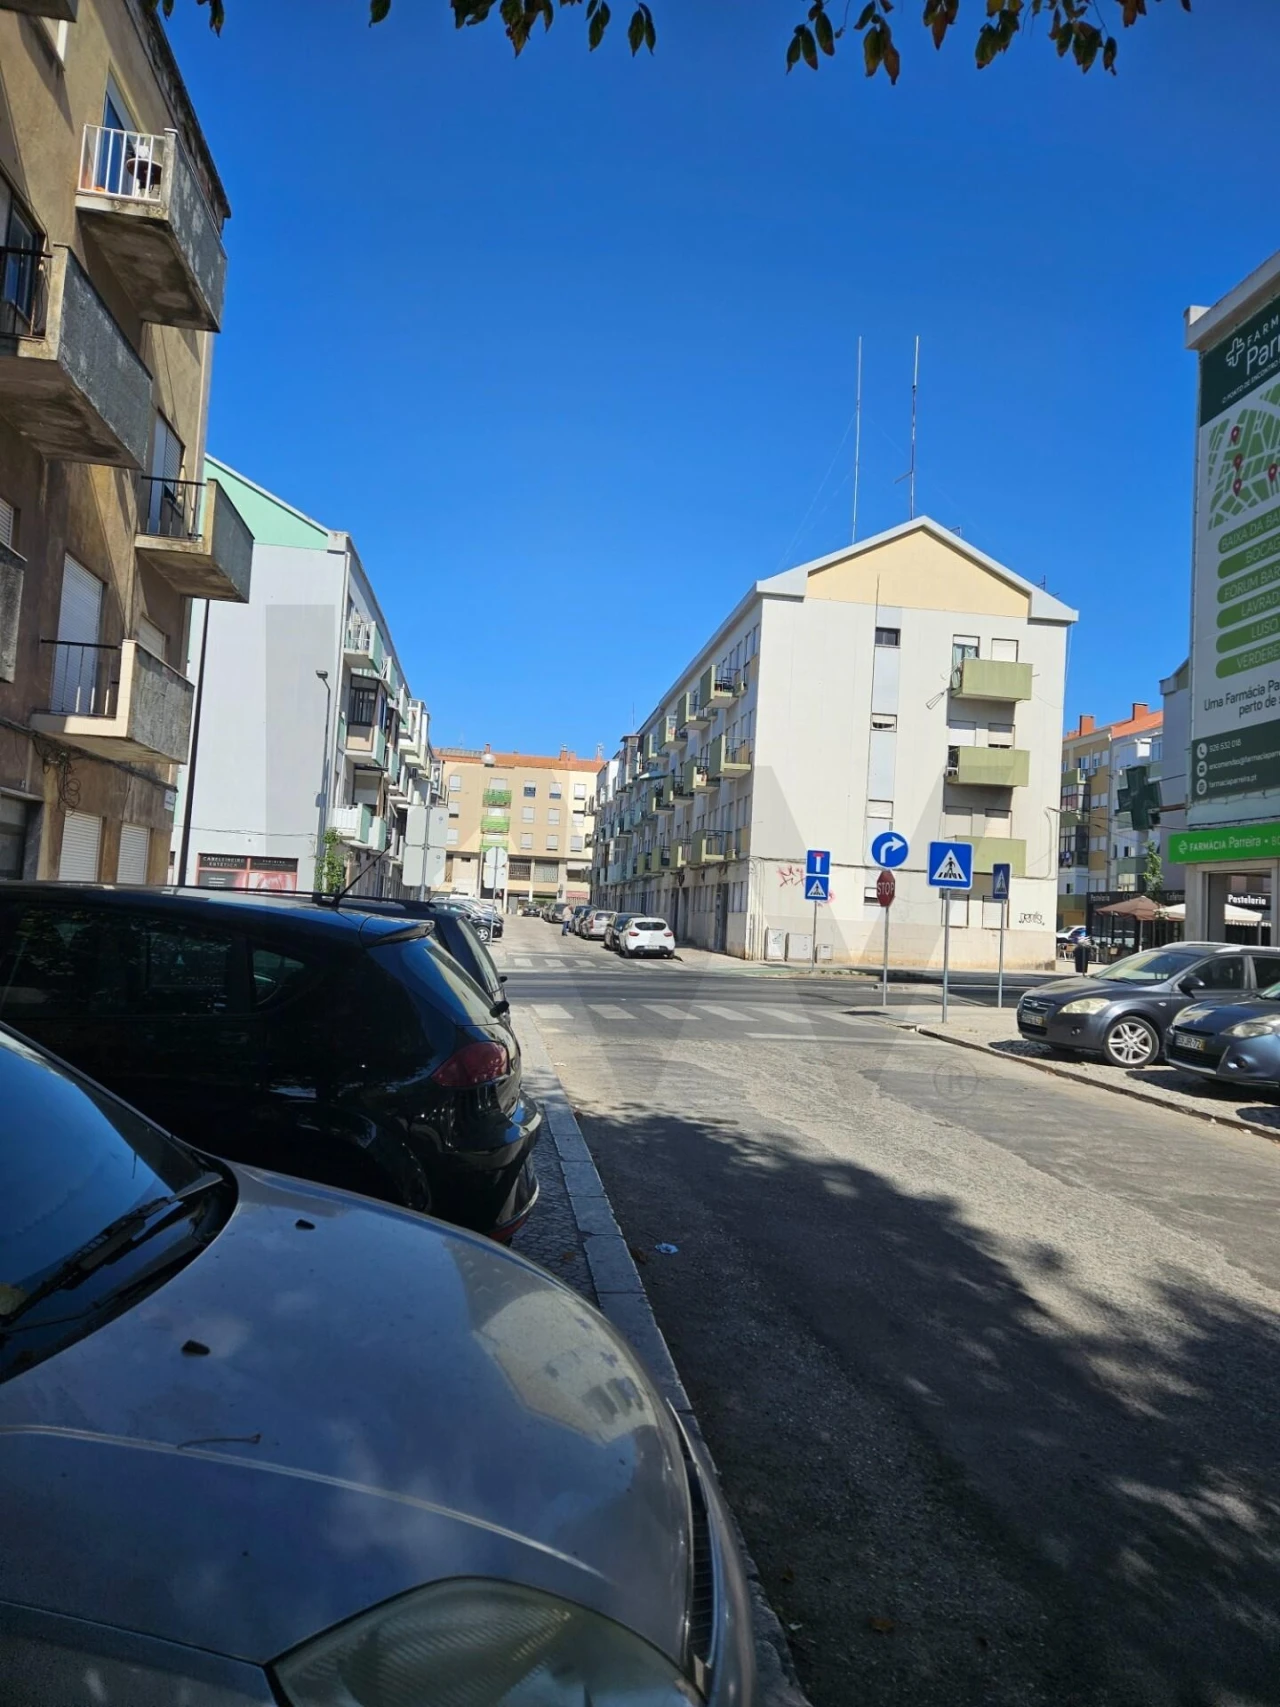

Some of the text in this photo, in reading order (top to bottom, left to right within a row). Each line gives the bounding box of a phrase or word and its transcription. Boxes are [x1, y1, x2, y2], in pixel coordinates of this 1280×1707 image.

[1251, 617, 1279, 639] LUSO
[1204, 697, 1224, 711] Uma
[1225, 684, 1266, 705] Farmácia
[1239, 693, 1277, 719] perto de
[1228, 836, 1261, 849] Parreira
[878, 882, 894, 896] STOP
[1227, 894, 1267, 905] Pastelaria
